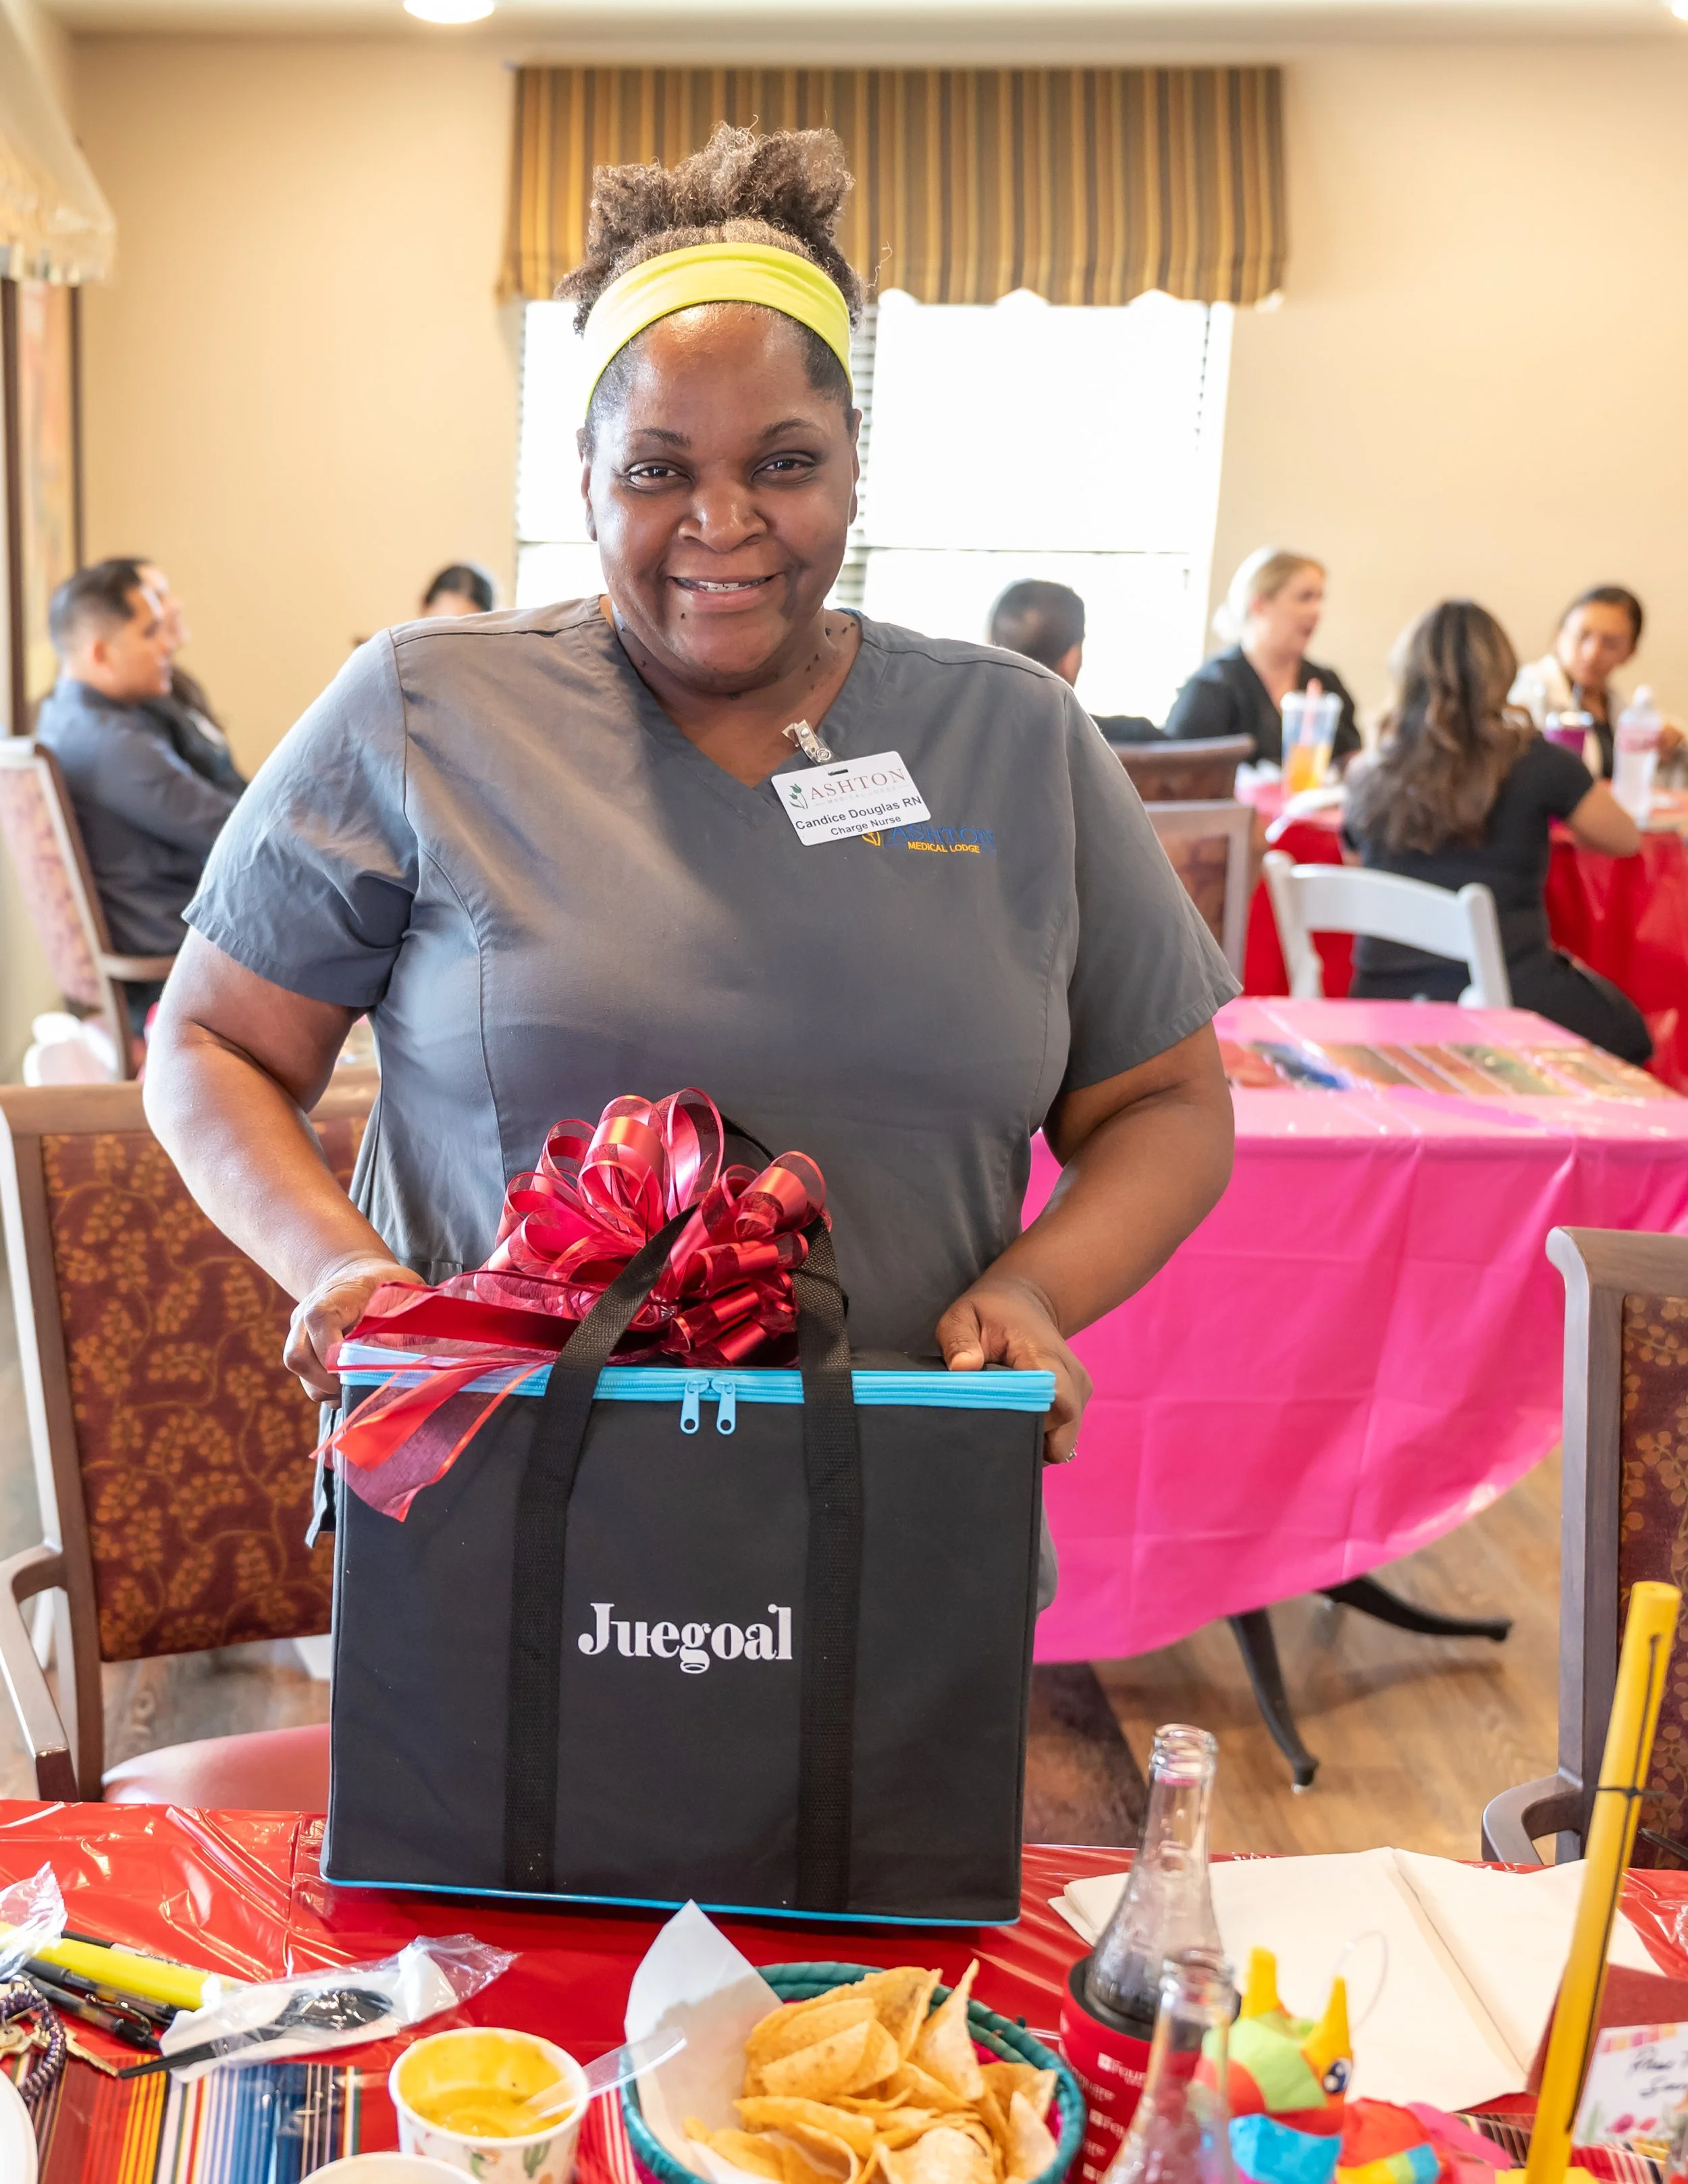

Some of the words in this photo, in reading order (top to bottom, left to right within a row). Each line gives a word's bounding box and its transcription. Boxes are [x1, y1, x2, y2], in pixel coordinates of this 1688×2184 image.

[811, 768, 905, 800] ASHTON
[827, 793, 864, 804] MEDICAL
[869, 786, 897, 796] LODGE
[795, 813, 847, 830] Candice
[848, 802, 900, 819] Douglas
[902, 795, 922, 807] RN
[830, 822, 869, 836] Charge
[870, 816, 901, 828] Nurse
[891, 824, 994, 845] ASHTON
[907, 841, 948, 853] MEDICAL
[949, 844, 980, 853] LODGE
[577, 1603, 793, 1674] Juegoal
